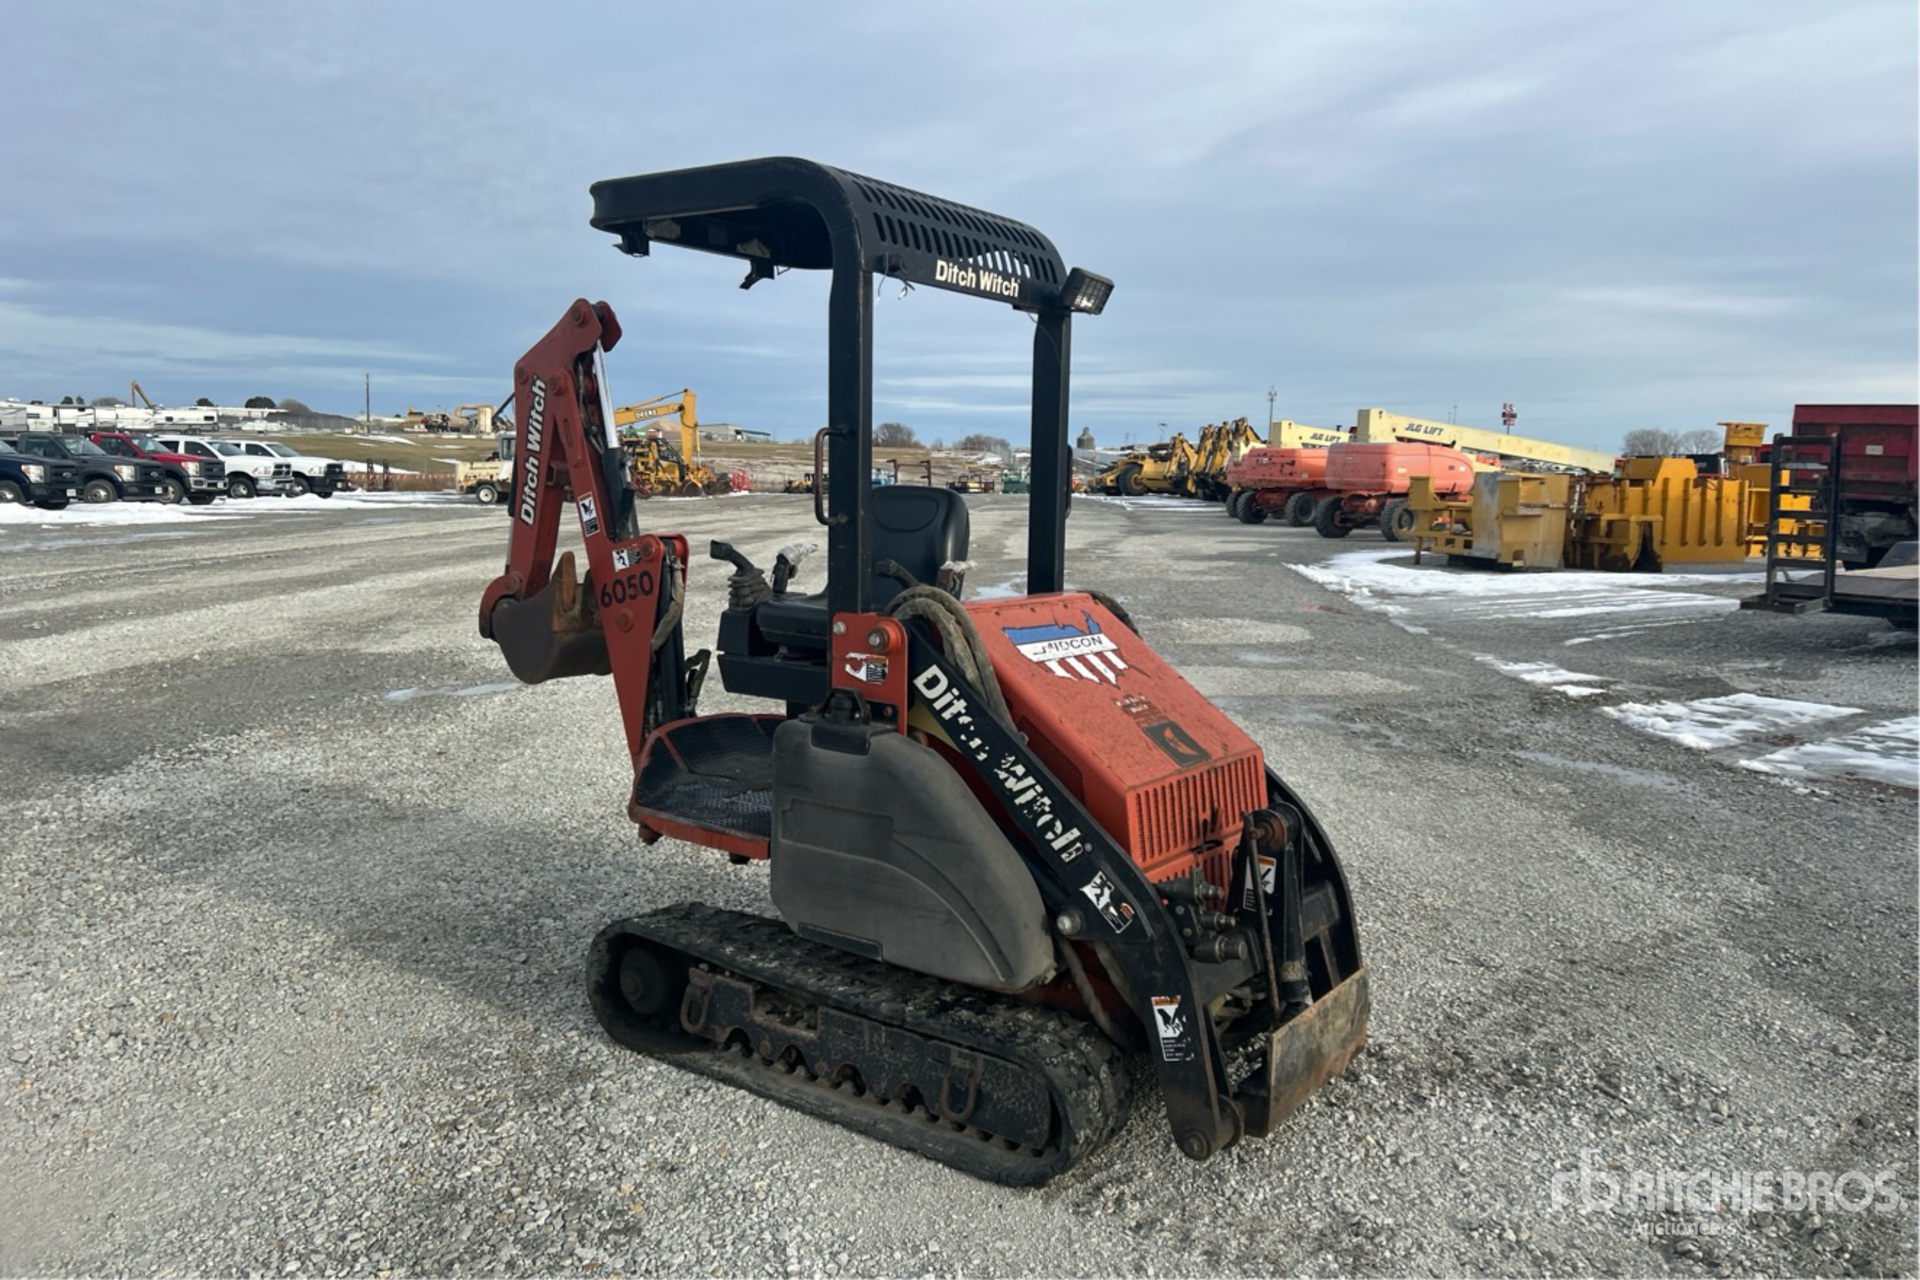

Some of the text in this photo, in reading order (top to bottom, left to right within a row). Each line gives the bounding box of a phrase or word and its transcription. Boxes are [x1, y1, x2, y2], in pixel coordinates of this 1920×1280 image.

[935, 260, 1019, 297] Ditch Witch
[1310, 432, 1325, 441] JLG
[1404, 423, 1444, 436] JLG LIFT
[520, 378, 547, 525] Ditch Witch
[601, 570, 654, 608] 6050
